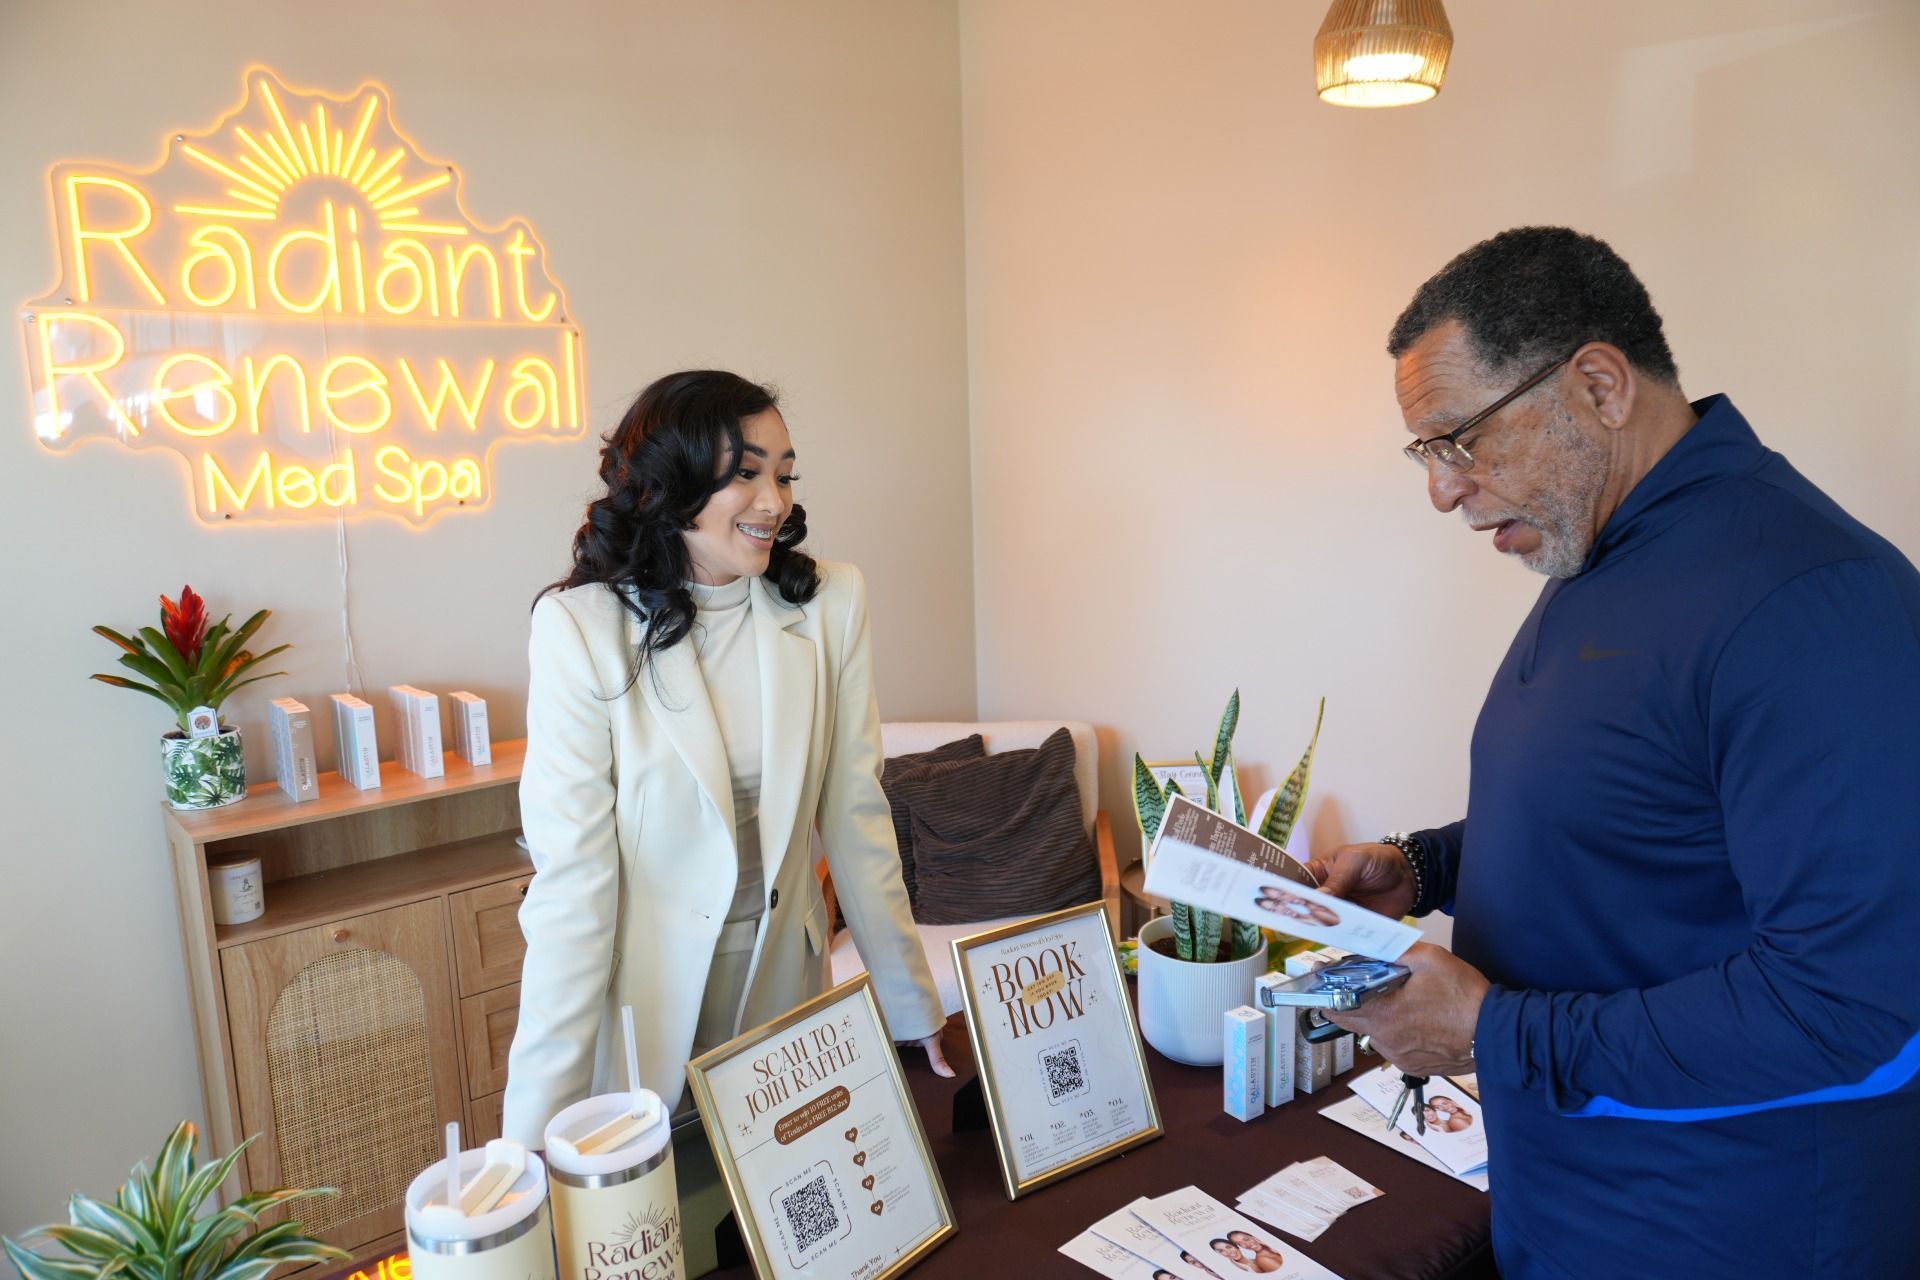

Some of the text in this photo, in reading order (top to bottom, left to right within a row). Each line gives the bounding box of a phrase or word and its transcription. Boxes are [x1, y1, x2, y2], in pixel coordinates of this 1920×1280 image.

[66, 175, 556, 322] Radiant
[37, 312, 578, 437] Renewal
[203, 445, 482, 516] Med Spa
[990, 941, 1087, 1003] BOOK
[1005, 978, 1085, 1039] NOW
[745, 1037, 860, 1122] JOIN RAFFLE
[753, 1023, 837, 1085] SCAN TO
[778, 1119, 793, 1131] Enter
[800, 1110, 810, 1119] win
[809, 1104, 817, 1114] 10
[816, 1096, 831, 1109] FREE
[780, 1133, 787, 1142] of
[812, 1111, 827, 1123] FREE
[785, 1167, 812, 1187] SCAN ME
[834, 1178, 848, 1210] SCAN ME
[584, 1233, 682, 1280] Rnewa
[588, 1206, 678, 1266] Radiant
[778, 1230, 788, 1251] SCAN
[811, 1240, 837, 1261] SCAN ME
[851, 1261, 869, 1279] Thank
[869, 1254, 882, 1265] You
